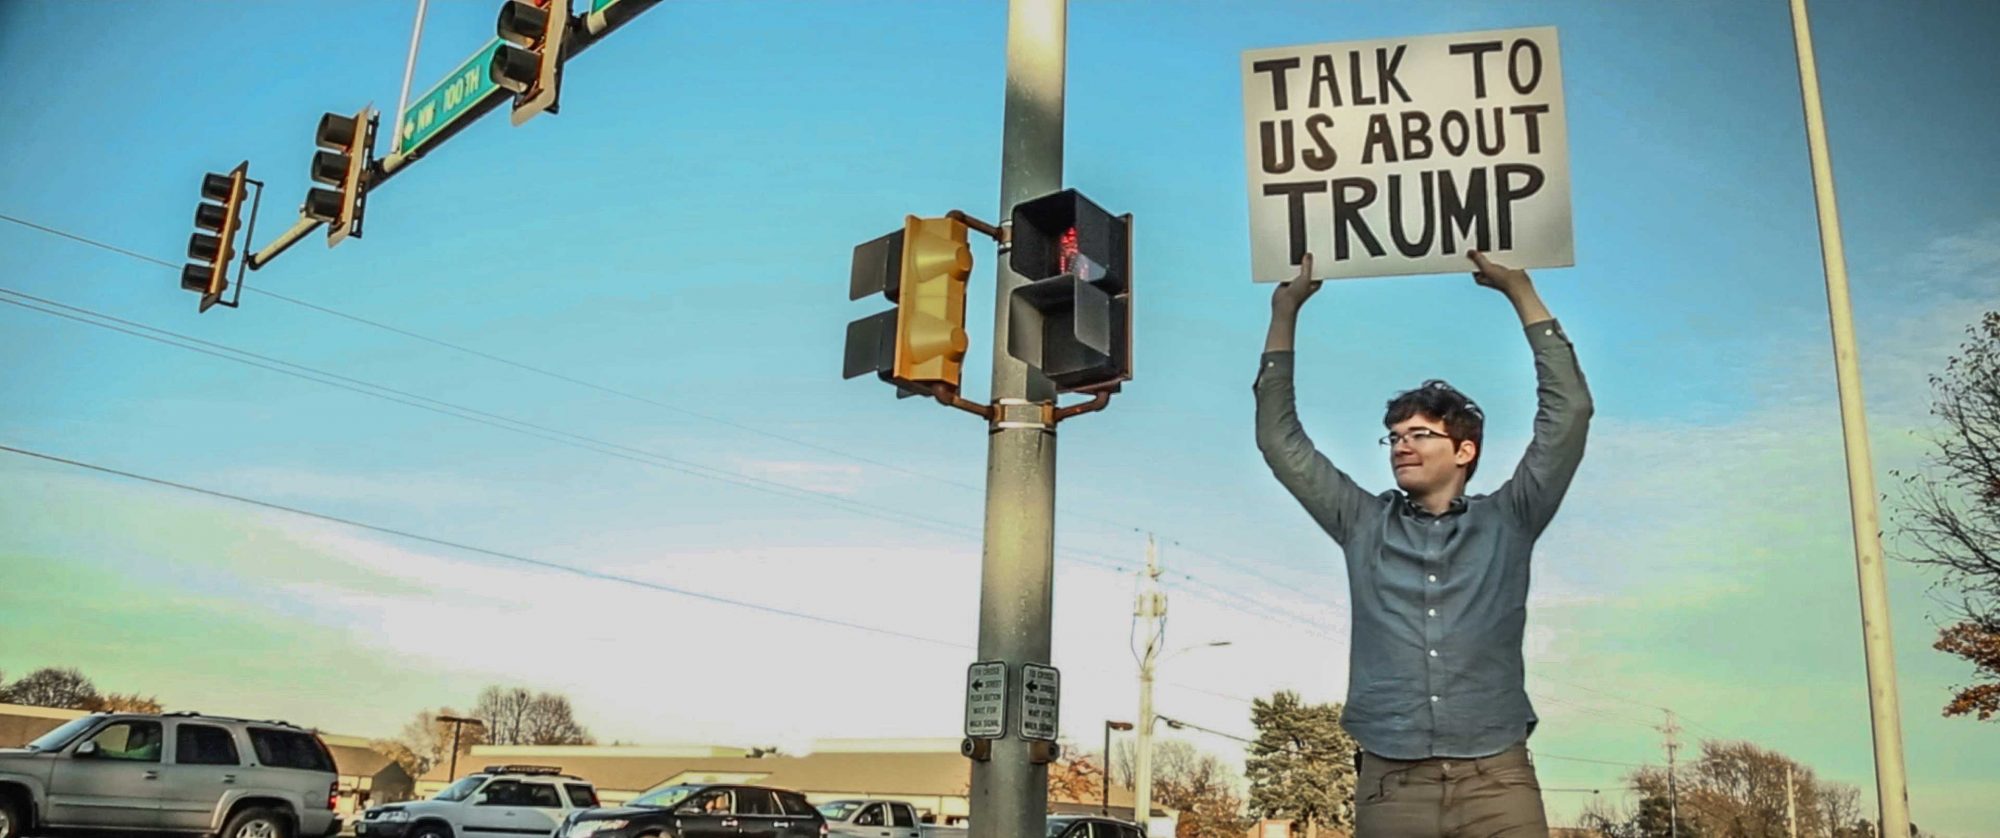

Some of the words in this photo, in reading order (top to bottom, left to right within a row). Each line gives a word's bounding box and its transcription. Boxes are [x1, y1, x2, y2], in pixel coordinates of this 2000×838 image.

[1253, 44, 1412, 111] TALK
[1449, 38, 1542, 99] TO
[1260, 113, 1338, 174] US
[1361, 104, 1549, 165] ABOUT
[1263, 163, 1545, 266] TRUMP
